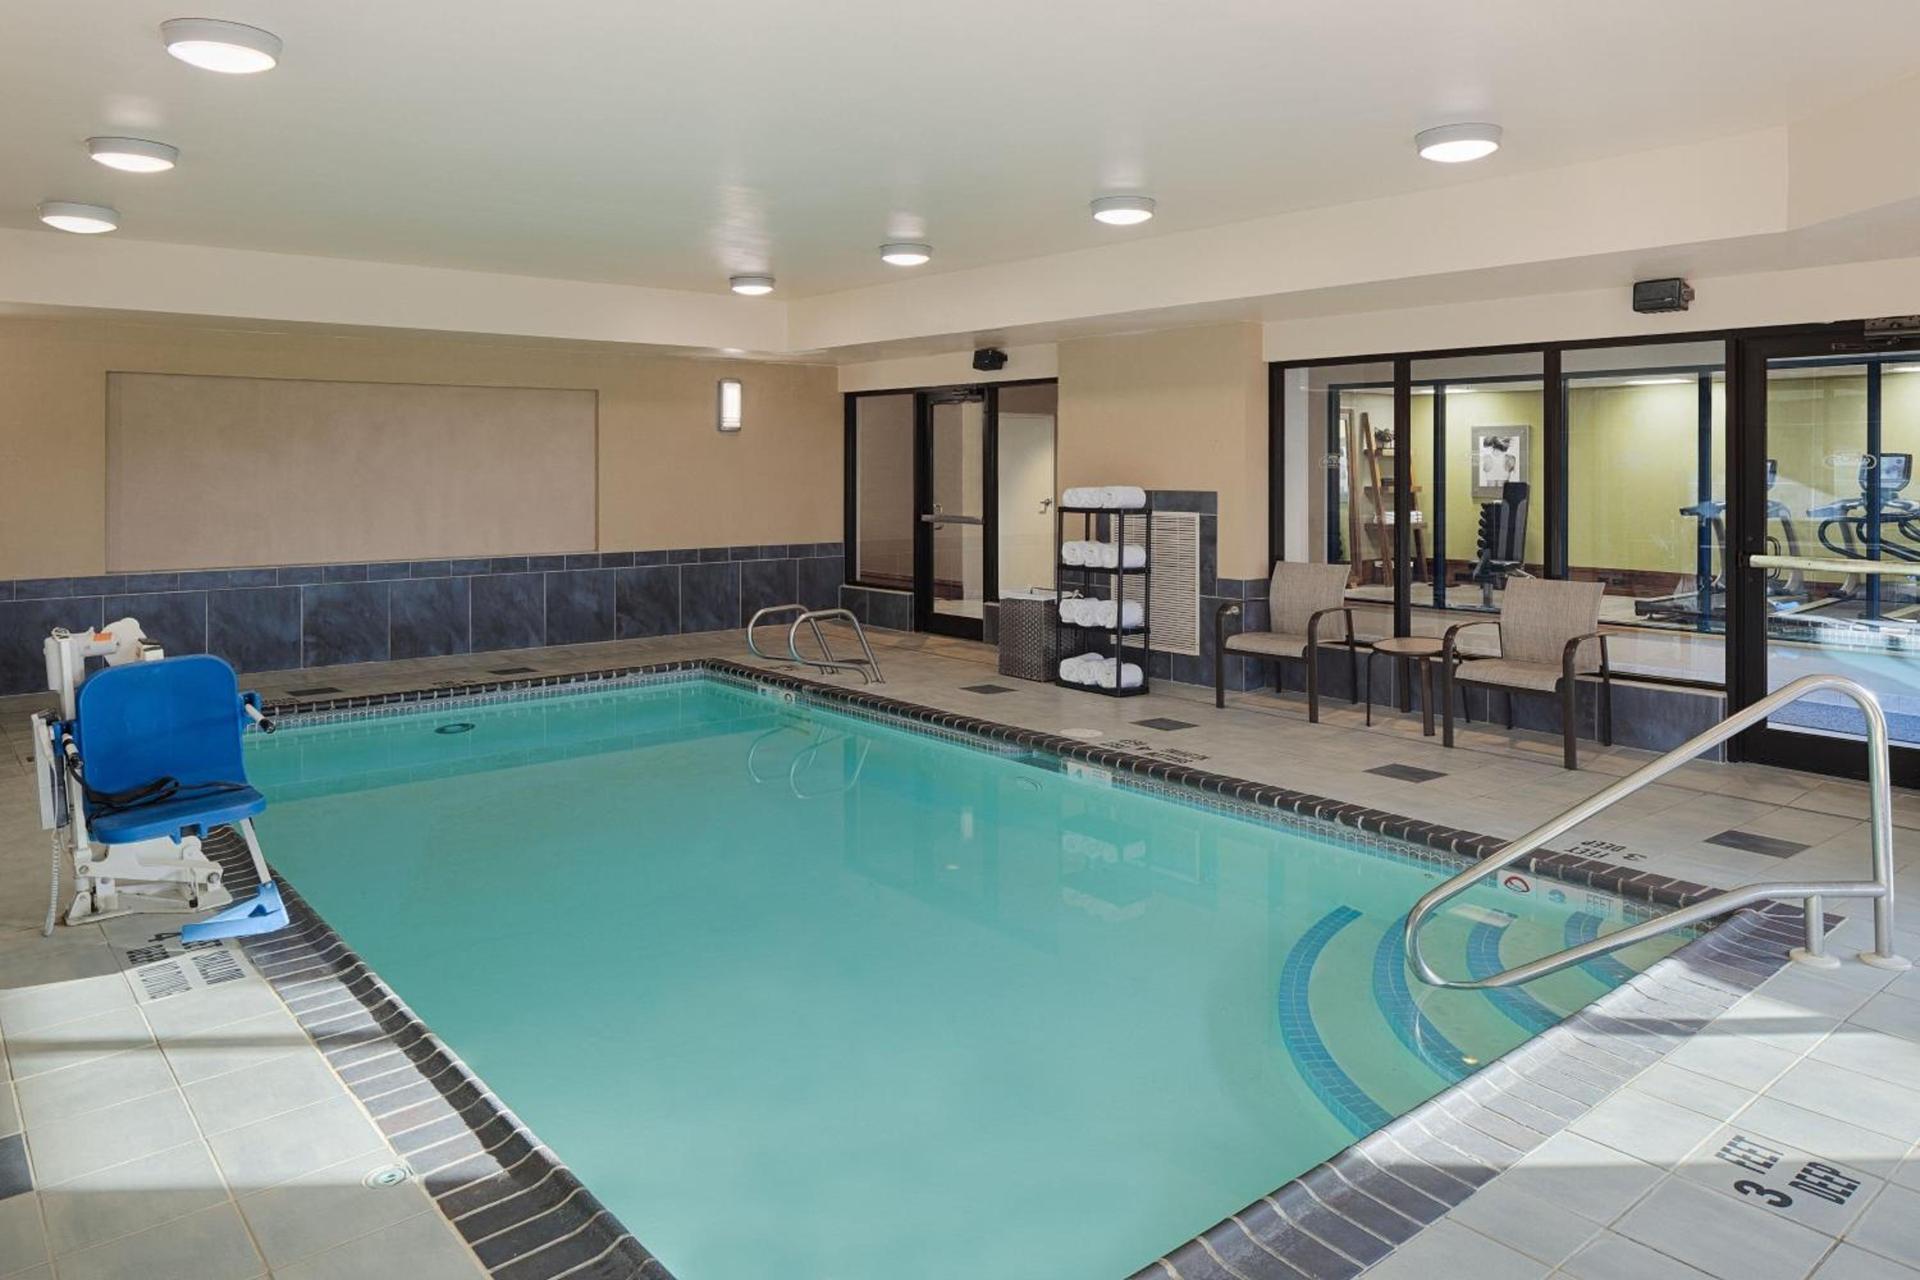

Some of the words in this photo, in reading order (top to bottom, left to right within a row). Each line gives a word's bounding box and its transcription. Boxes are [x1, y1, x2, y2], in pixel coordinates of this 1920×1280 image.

[1566, 847, 1610, 859] FEET
[1581, 839, 1627, 854] DEEP
[1622, 854, 1648, 862] 3
[148, 933, 183, 942] 4
[1715, 1134, 1785, 1176] FEET
[1787, 1161, 1862, 1206] DEEP
[1733, 1179, 1794, 1209] 3
